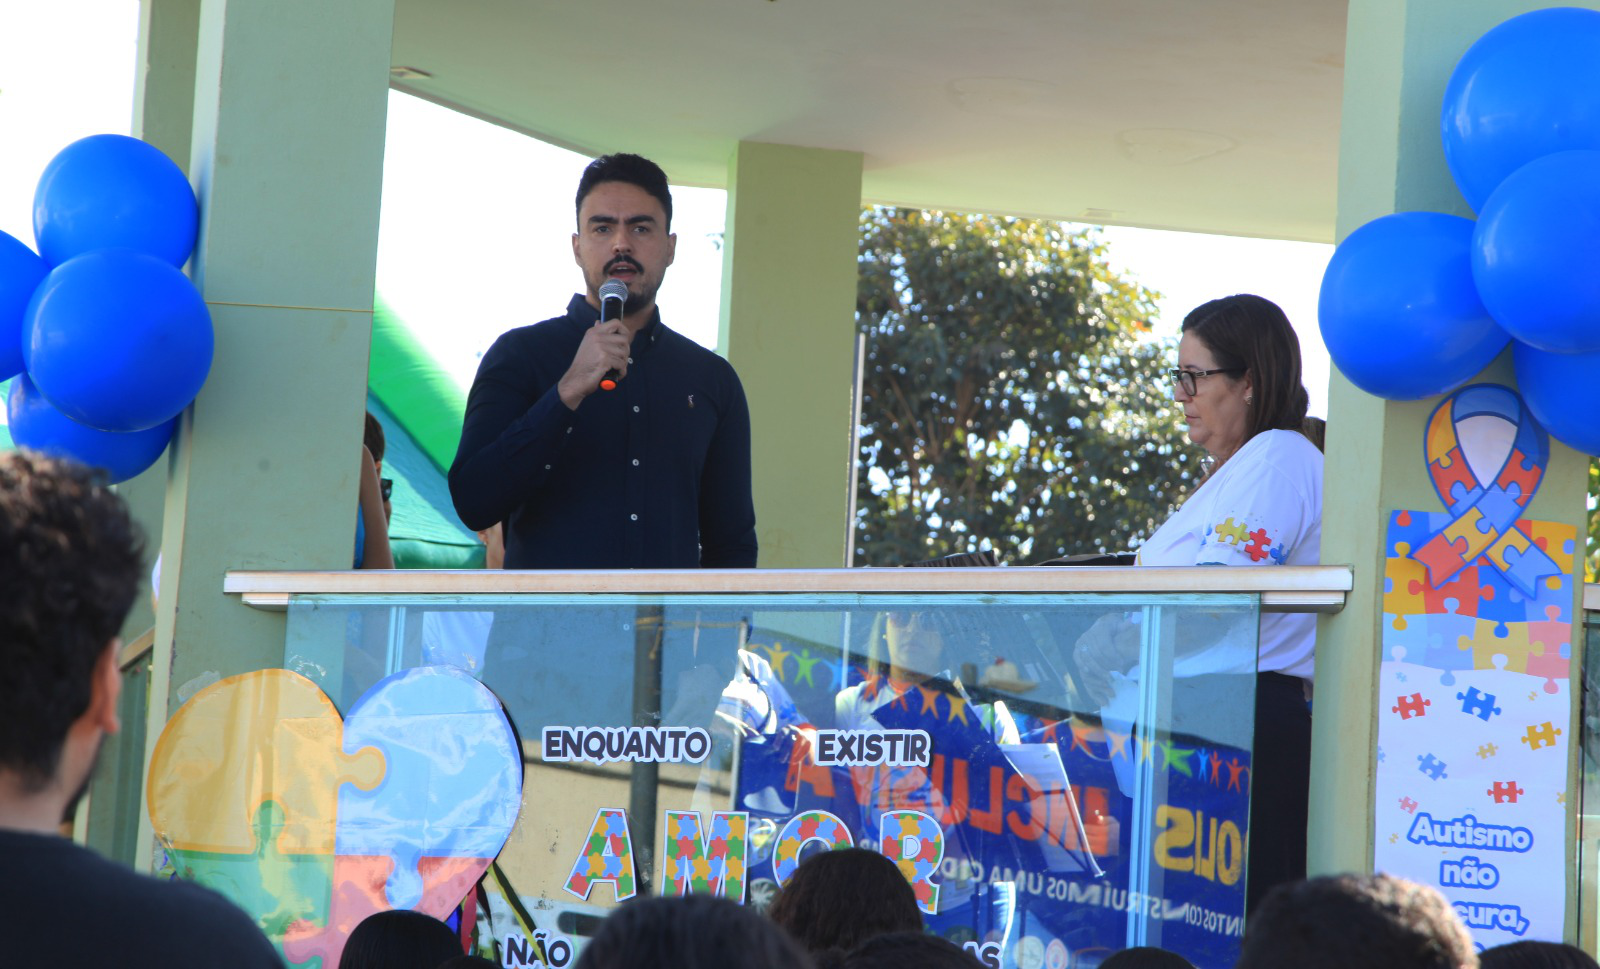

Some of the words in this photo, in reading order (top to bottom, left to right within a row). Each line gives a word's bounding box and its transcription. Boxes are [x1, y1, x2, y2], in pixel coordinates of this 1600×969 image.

[544, 729, 708, 761] ENQUANTO
[817, 732, 928, 763] EXISTIR
[1407, 814, 1532, 851] Autismo
[562, 807, 944, 914] AMOR
[1441, 857, 1499, 889] não
[506, 932, 571, 968] NÃO
